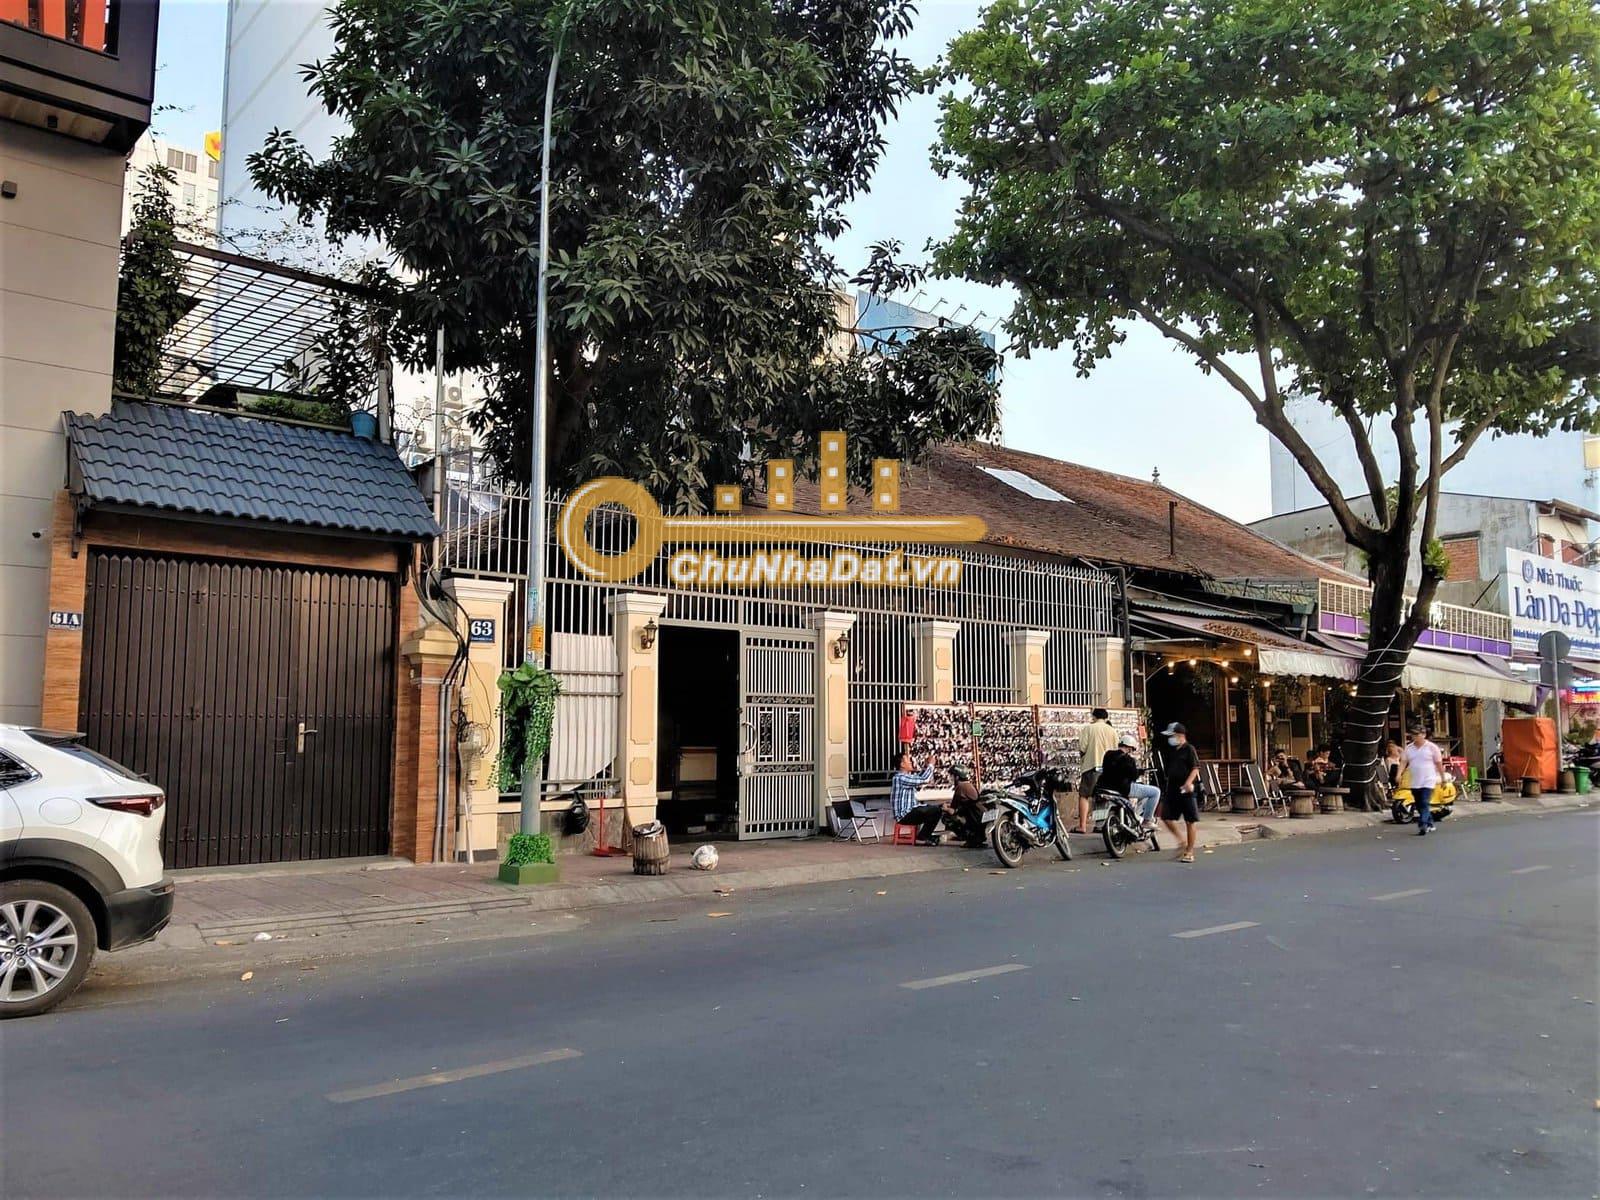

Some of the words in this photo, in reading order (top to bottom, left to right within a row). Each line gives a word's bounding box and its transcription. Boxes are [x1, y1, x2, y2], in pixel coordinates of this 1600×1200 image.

[1537, 567, 1555, 586] Nhà
[1555, 573, 1583, 592] Thuốc
[1514, 586, 1547, 622] Làn
[1548, 594, 1571, 626] Da
[52, 612, 80, 625] 61A
[470, 620, 493, 636] 63
